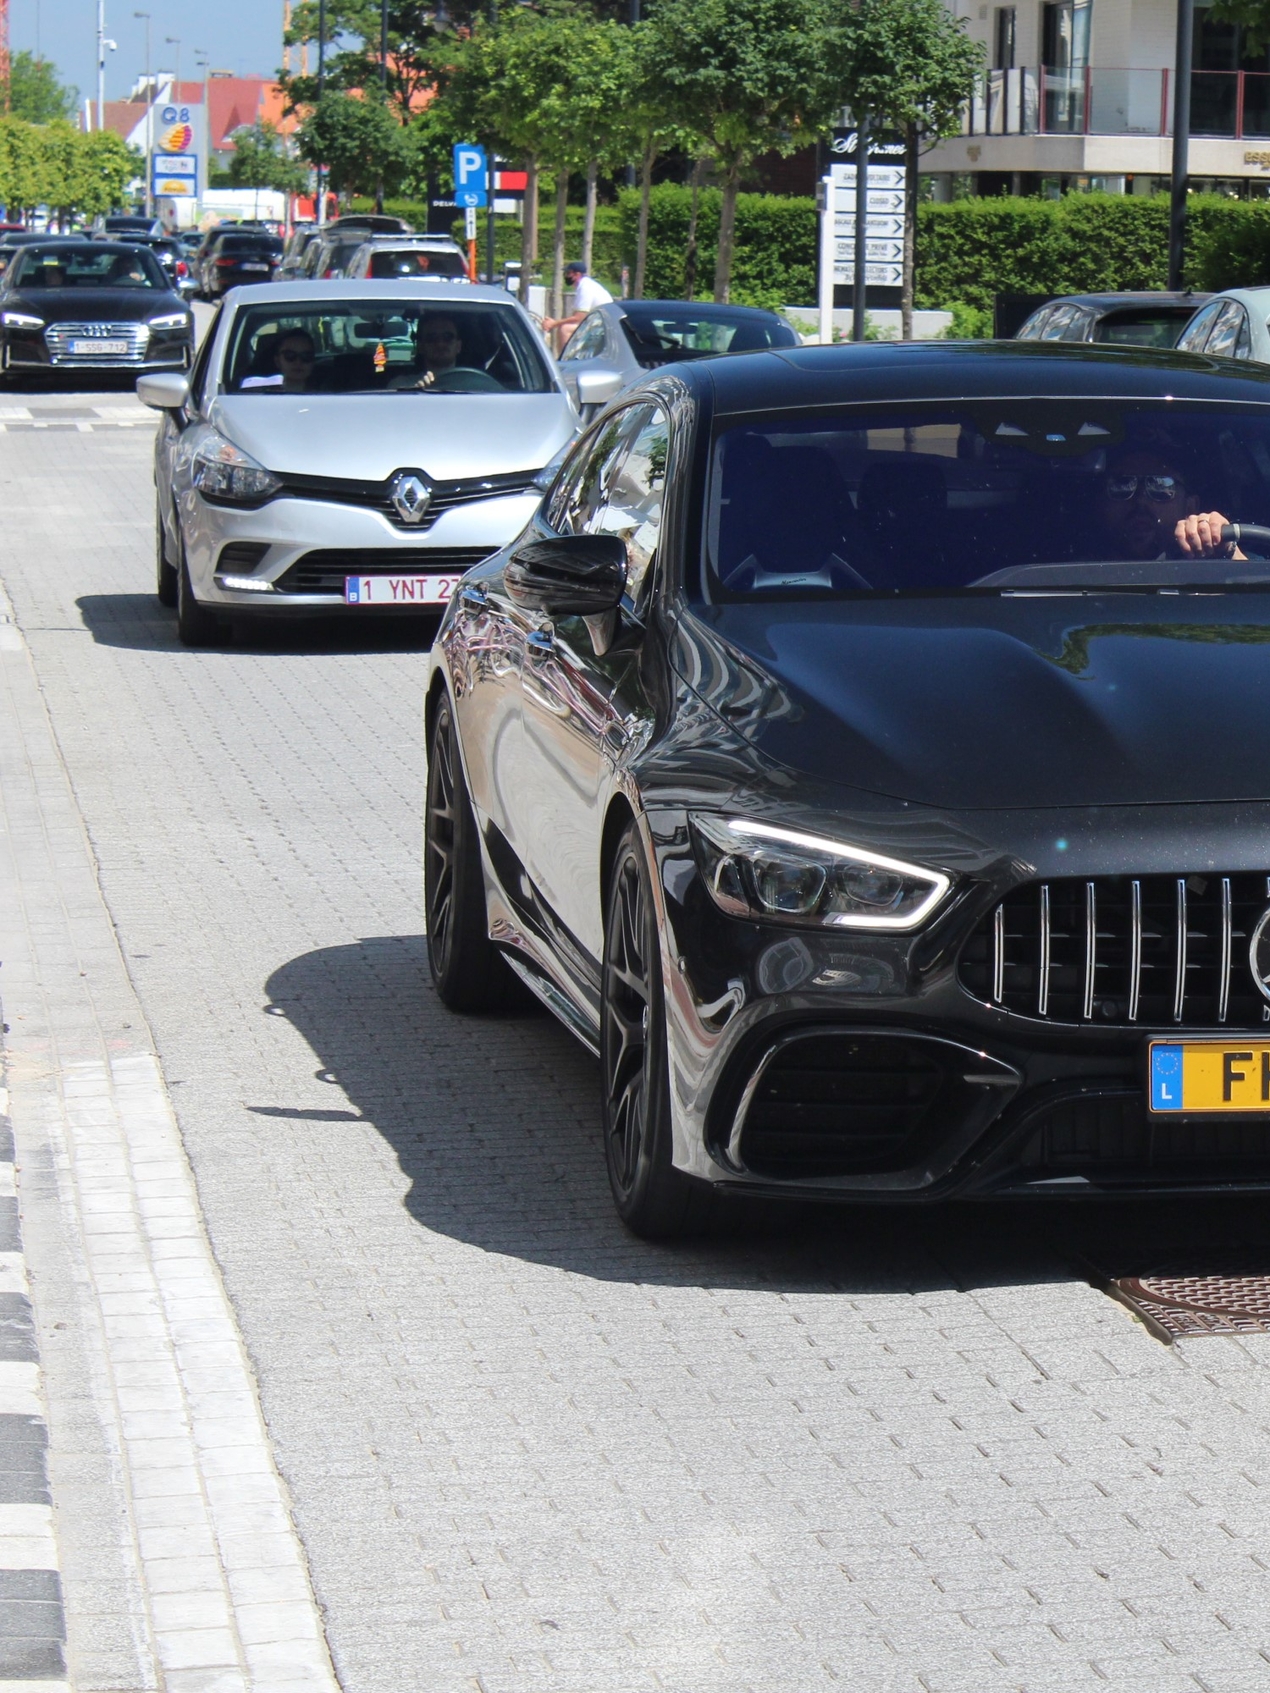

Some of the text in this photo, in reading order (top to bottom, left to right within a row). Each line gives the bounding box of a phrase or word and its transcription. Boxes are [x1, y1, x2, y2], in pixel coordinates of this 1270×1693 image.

[162, 106, 190, 123] Q8
[458, 151, 482, 185] P
[350, 592, 358, 601] B
[364, 580, 372, 600] 1
[388, 579, 428, 600] YNT
[1161, 1083, 1172, 1100] L
